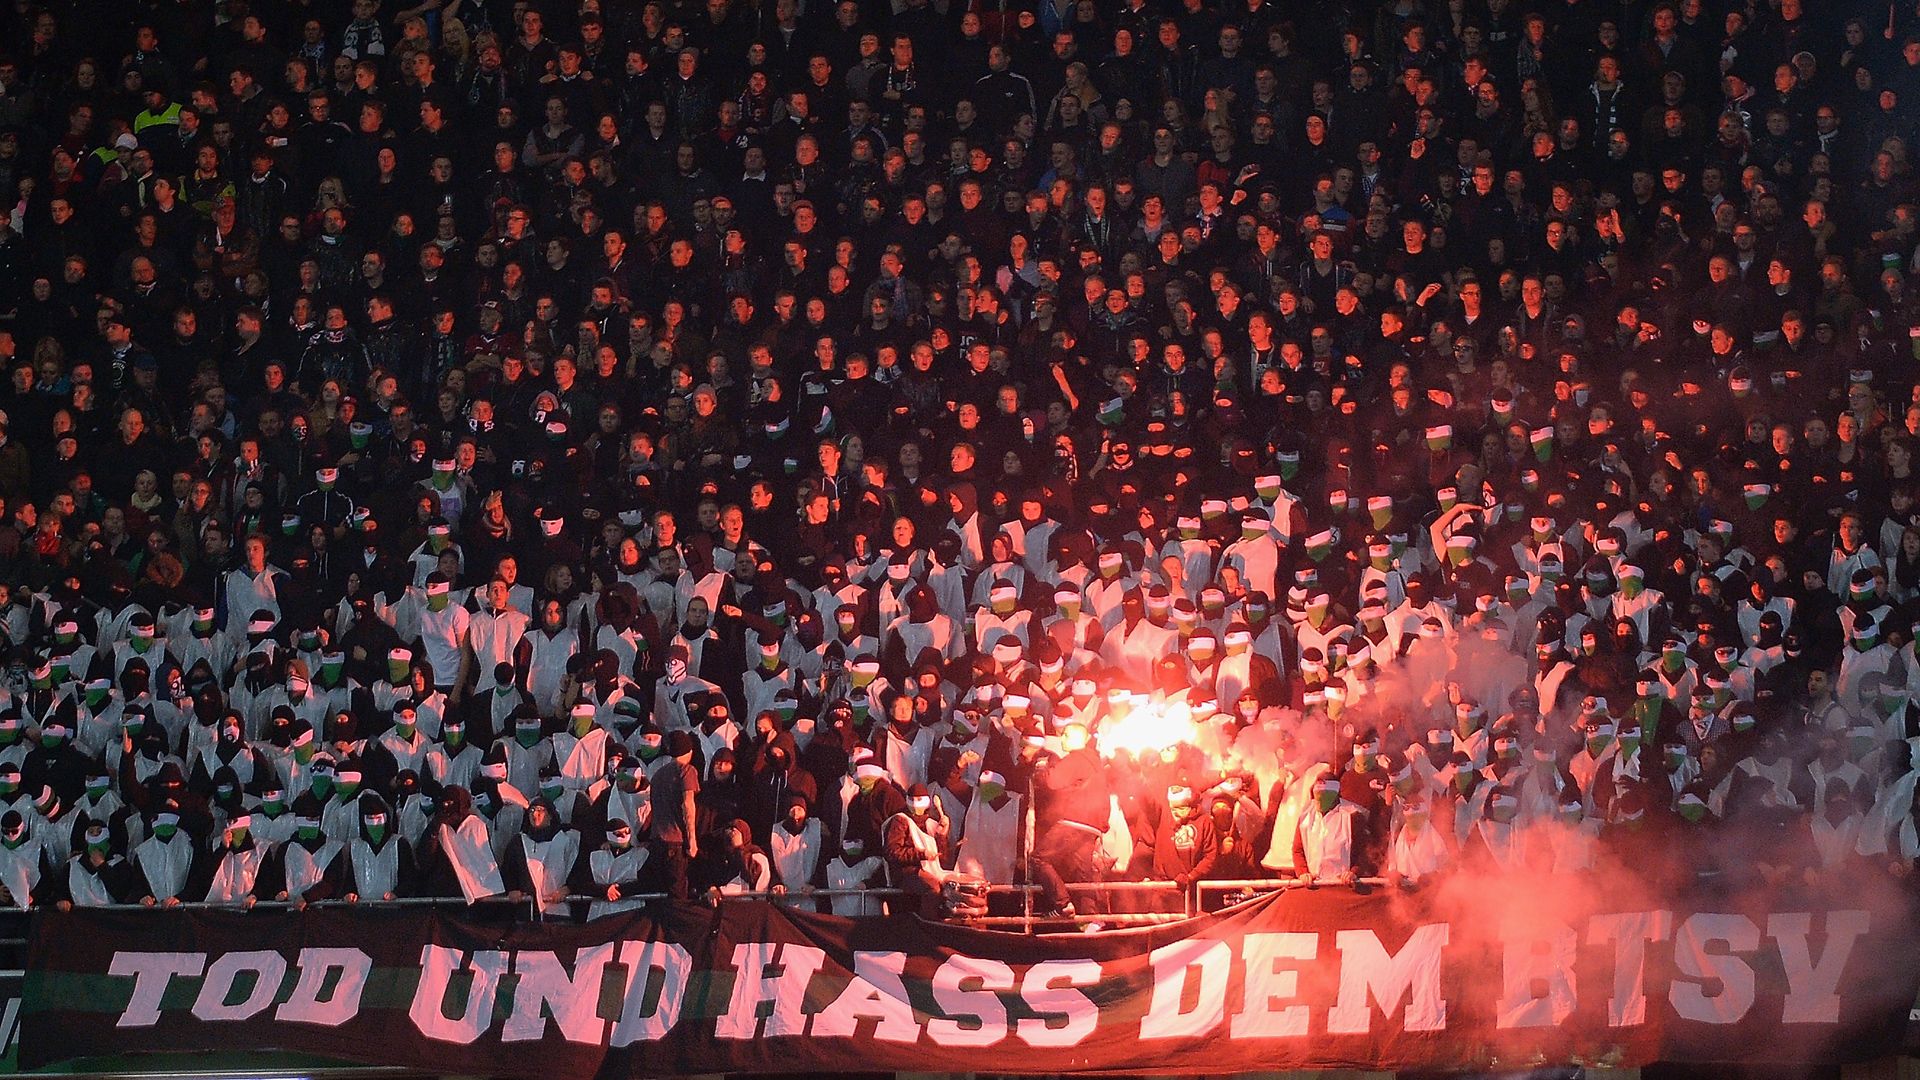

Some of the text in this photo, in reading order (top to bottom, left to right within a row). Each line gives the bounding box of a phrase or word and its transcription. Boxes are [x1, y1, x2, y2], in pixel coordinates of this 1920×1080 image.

[107, 948, 373, 1027] TOD
[408, 940, 693, 1047] UND
[715, 943, 1102, 1047] HASS
[1138, 922, 1450, 1040] DEM
[1496, 909, 1871, 1029] BTSV
